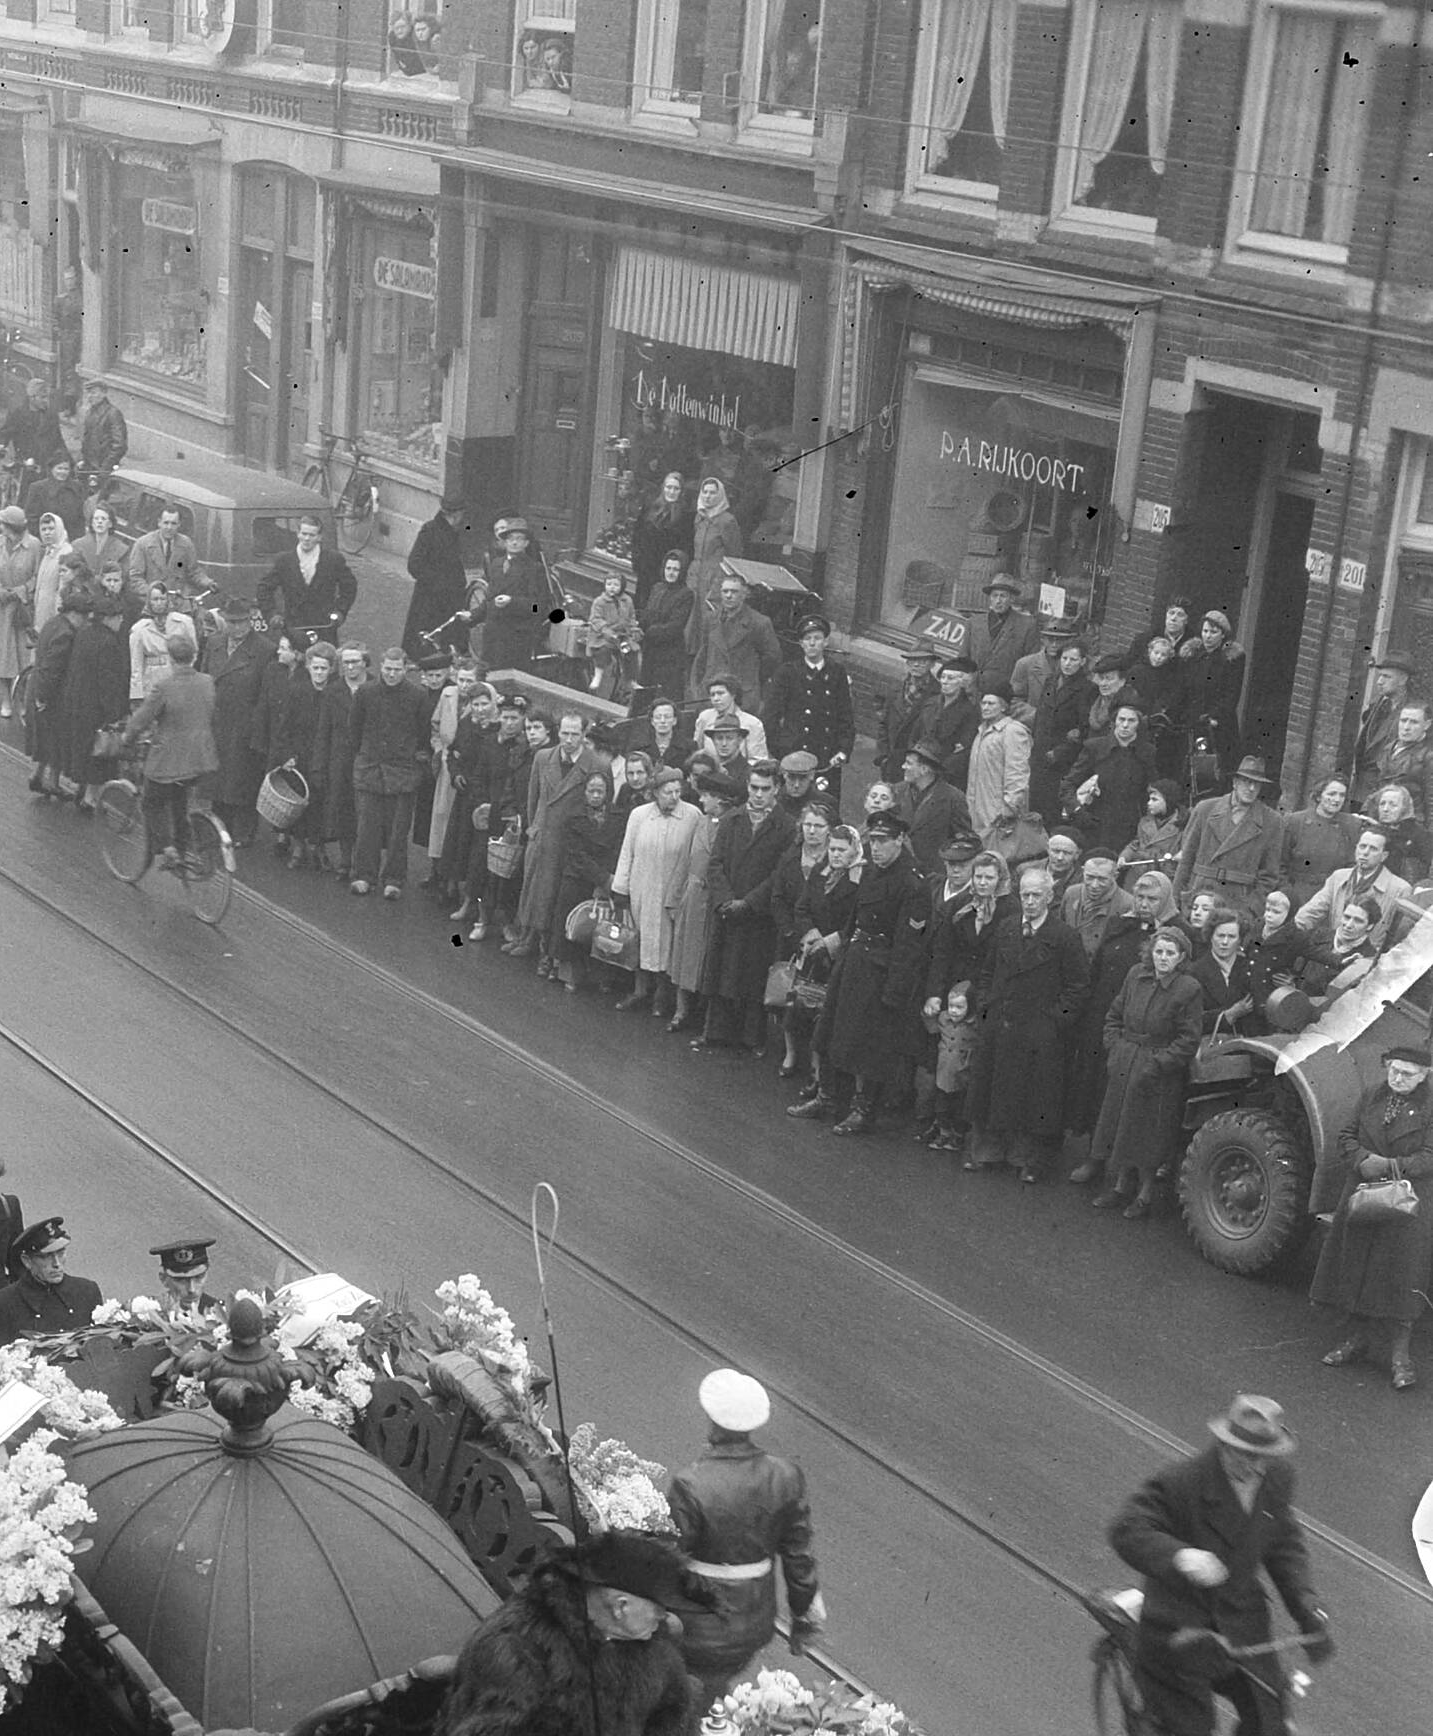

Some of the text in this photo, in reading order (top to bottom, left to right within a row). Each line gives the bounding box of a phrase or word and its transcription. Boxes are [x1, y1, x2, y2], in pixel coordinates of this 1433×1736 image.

[631, 366, 657, 411] De
[1343, 563, 1364, 585] 201
[922, 615, 964, 646] ZAD
